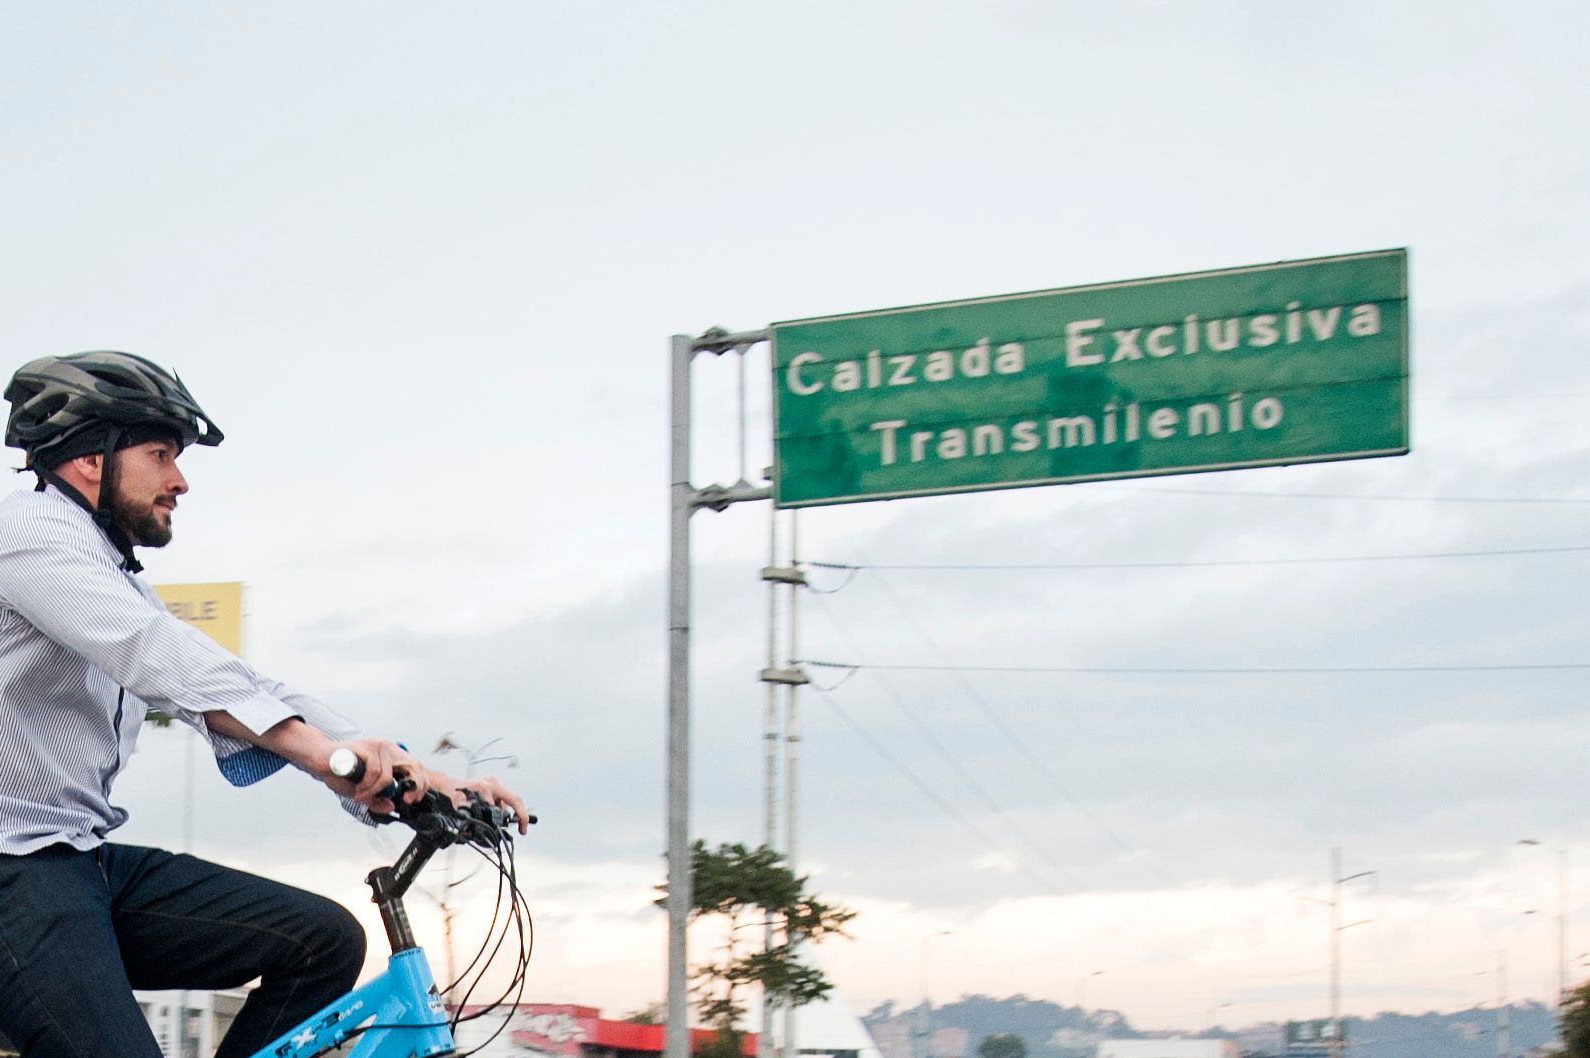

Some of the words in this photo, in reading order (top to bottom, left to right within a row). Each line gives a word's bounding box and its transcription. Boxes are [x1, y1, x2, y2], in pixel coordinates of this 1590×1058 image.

[786, 338, 1026, 397] Calzada
[1065, 301, 1383, 368] Exclusiva
[870, 391, 1284, 466] Transmilenio
